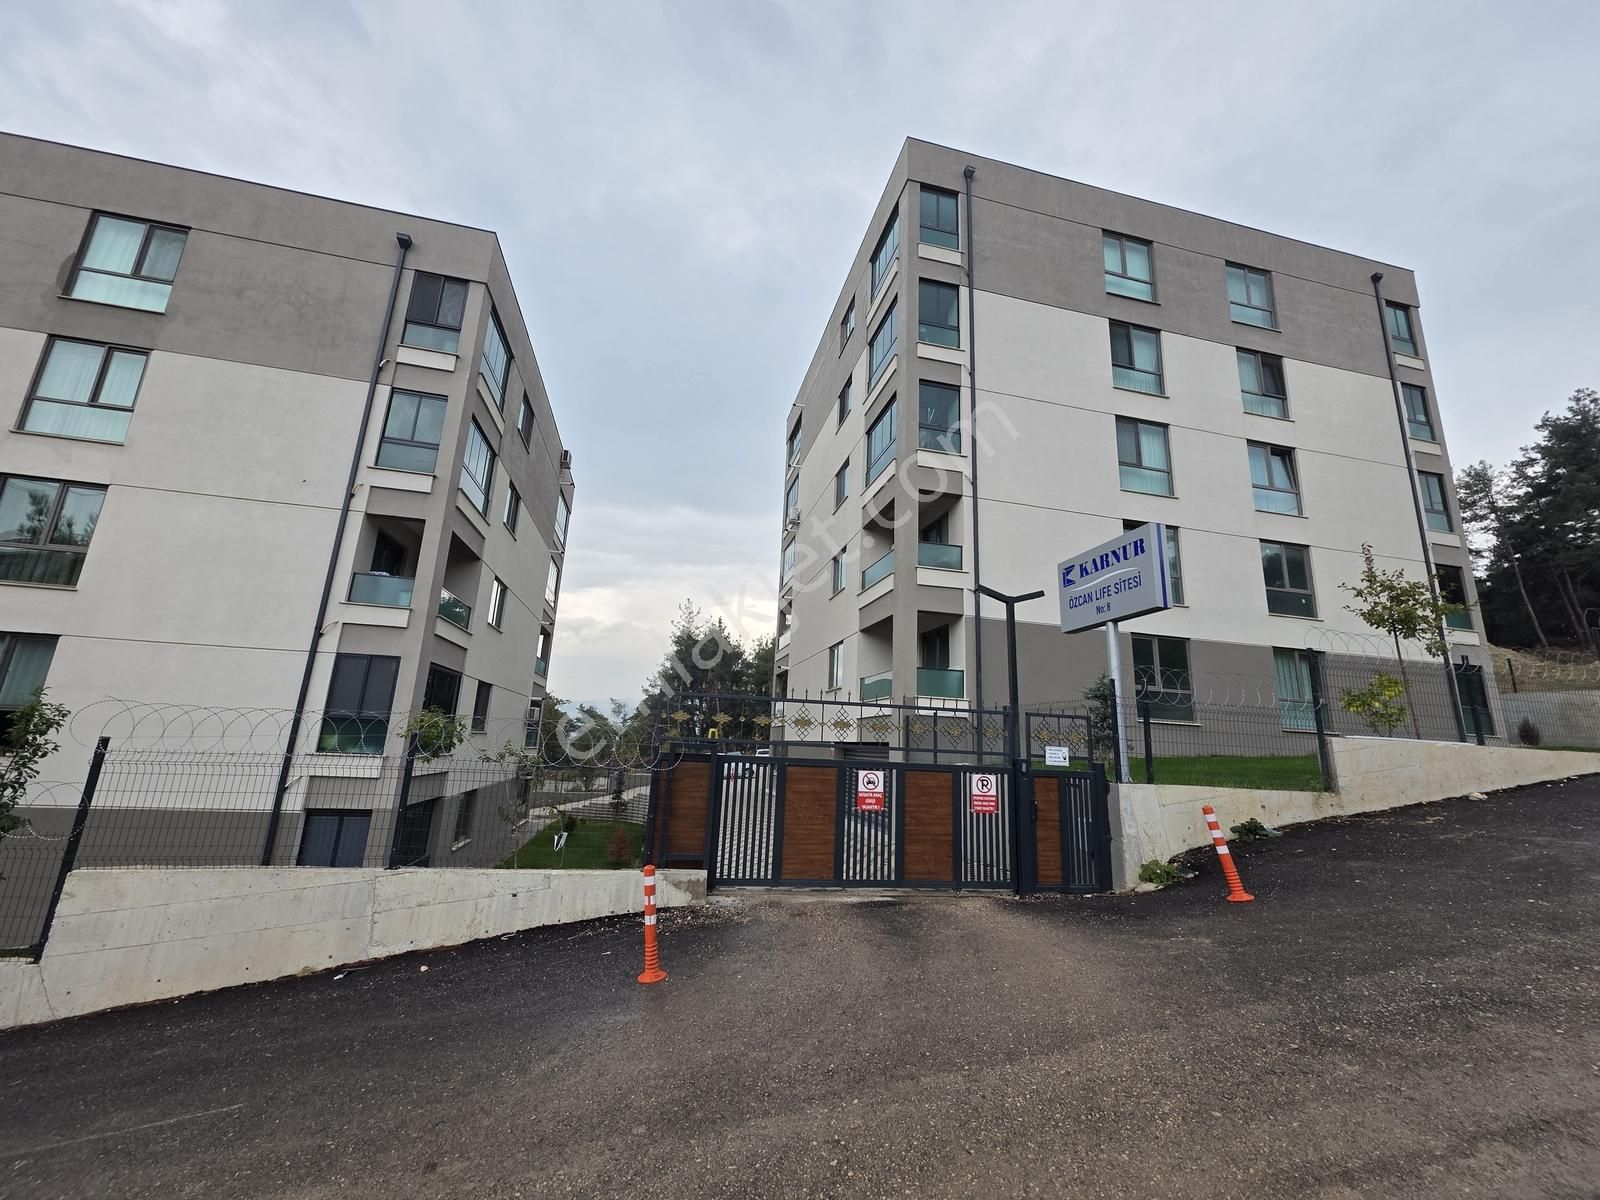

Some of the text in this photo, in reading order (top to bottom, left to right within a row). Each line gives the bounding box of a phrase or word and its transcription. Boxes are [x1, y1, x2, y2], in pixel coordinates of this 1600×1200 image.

[1079, 538, 1145, 579] KARNUR
[1068, 571, 1142, 609] ÖZCAN LIFE SİTESİ
